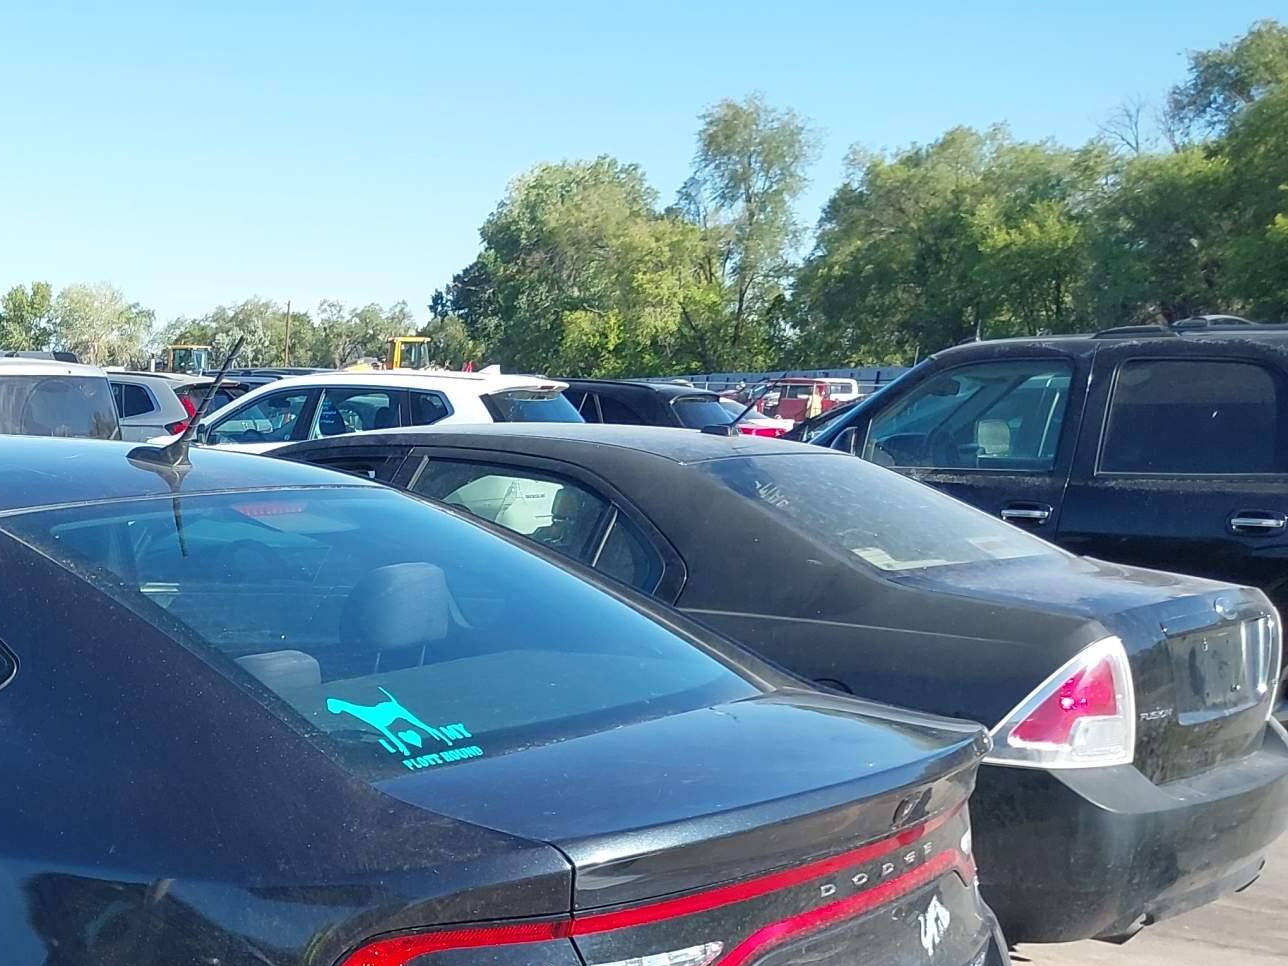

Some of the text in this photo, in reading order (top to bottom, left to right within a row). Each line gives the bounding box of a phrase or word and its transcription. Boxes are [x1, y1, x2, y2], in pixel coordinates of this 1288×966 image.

[439, 723, 472, 740] MY
[402, 746, 483, 770] PLOTT HOUND
[820, 841, 933, 897] DODGE
